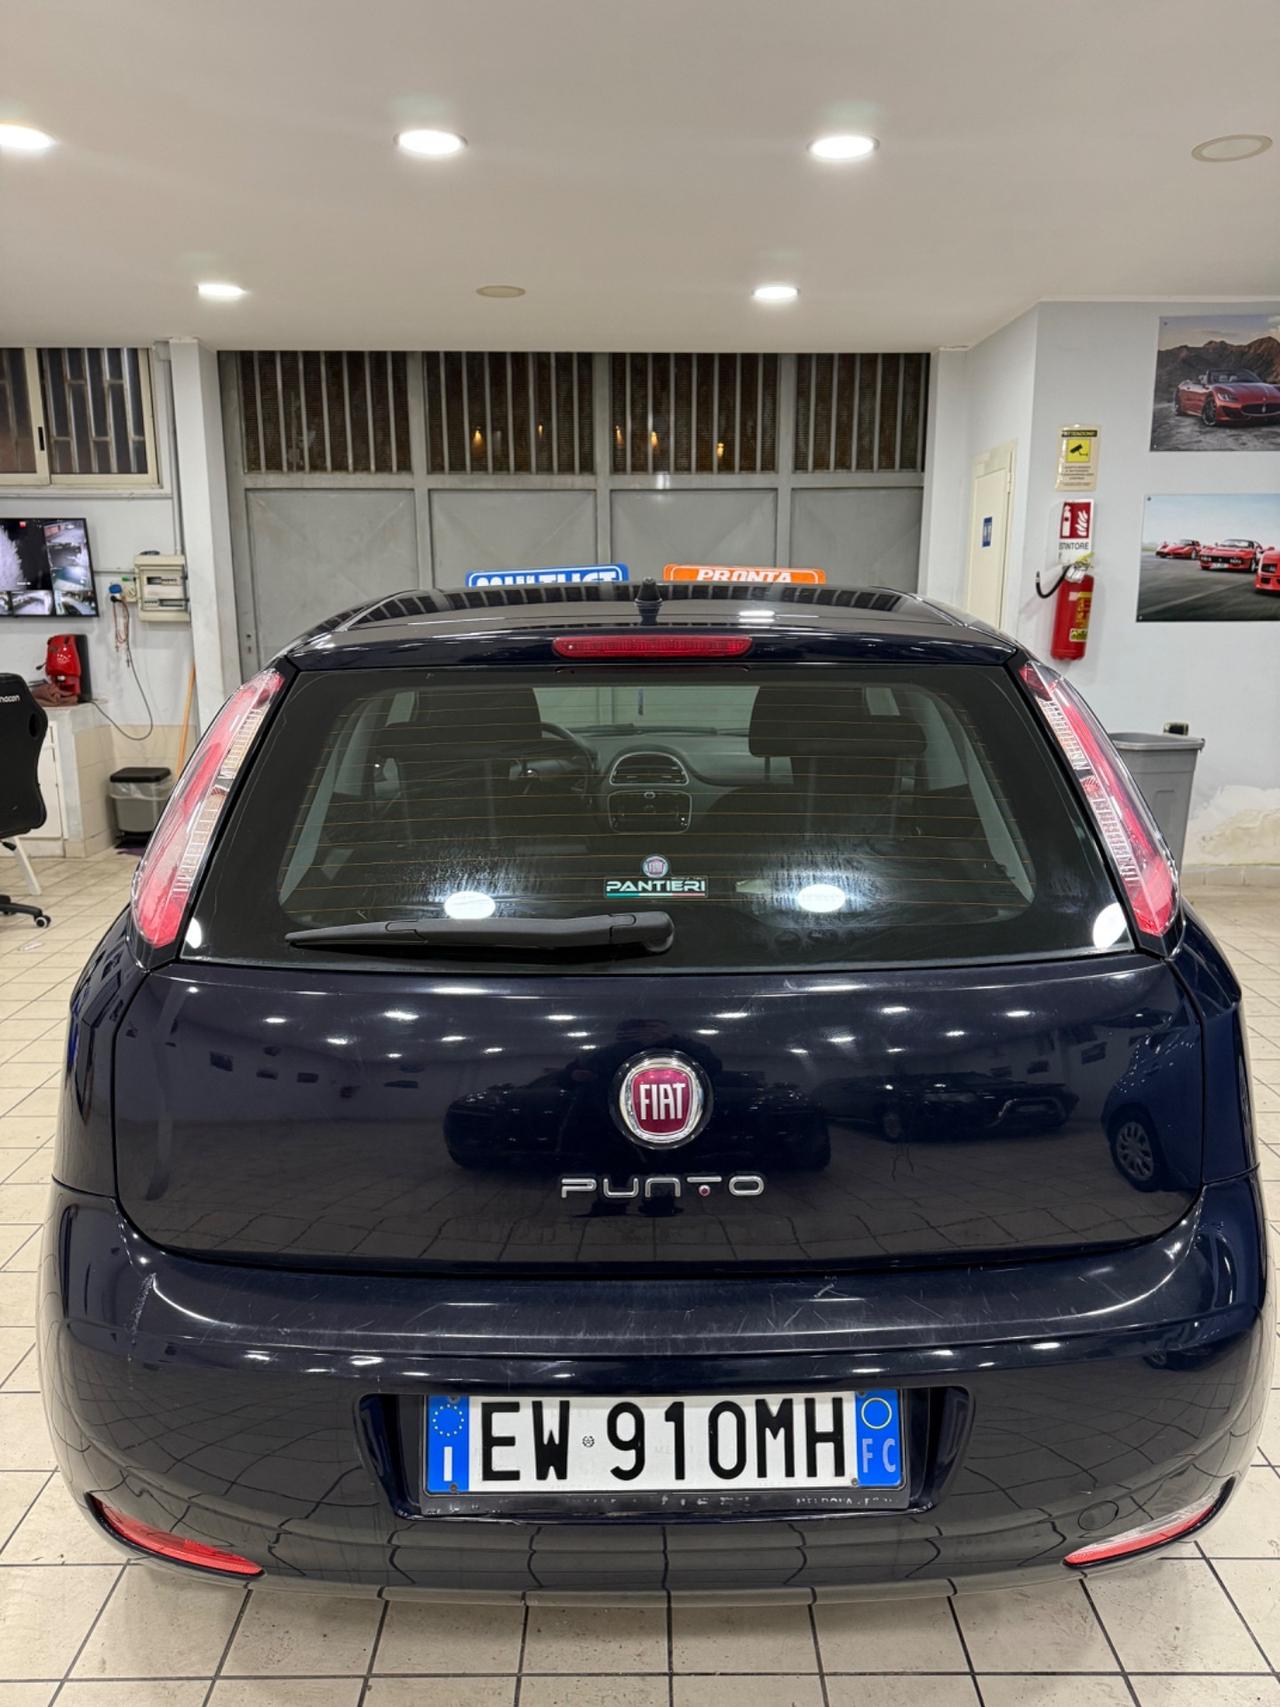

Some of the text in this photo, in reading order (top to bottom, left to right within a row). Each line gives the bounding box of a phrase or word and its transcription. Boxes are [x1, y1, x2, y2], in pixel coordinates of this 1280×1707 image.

[696, 568, 792, 583] PRONTA
[606, 880, 706, 892] PANTIERI
[639, 1083, 686, 1120] FIAT
[561, 1175, 765, 1198] PUNTO
[481, 1400, 570, 1481] EW
[606, 1397, 846, 1481] 910MH
[861, 1438, 896, 1473] FC
